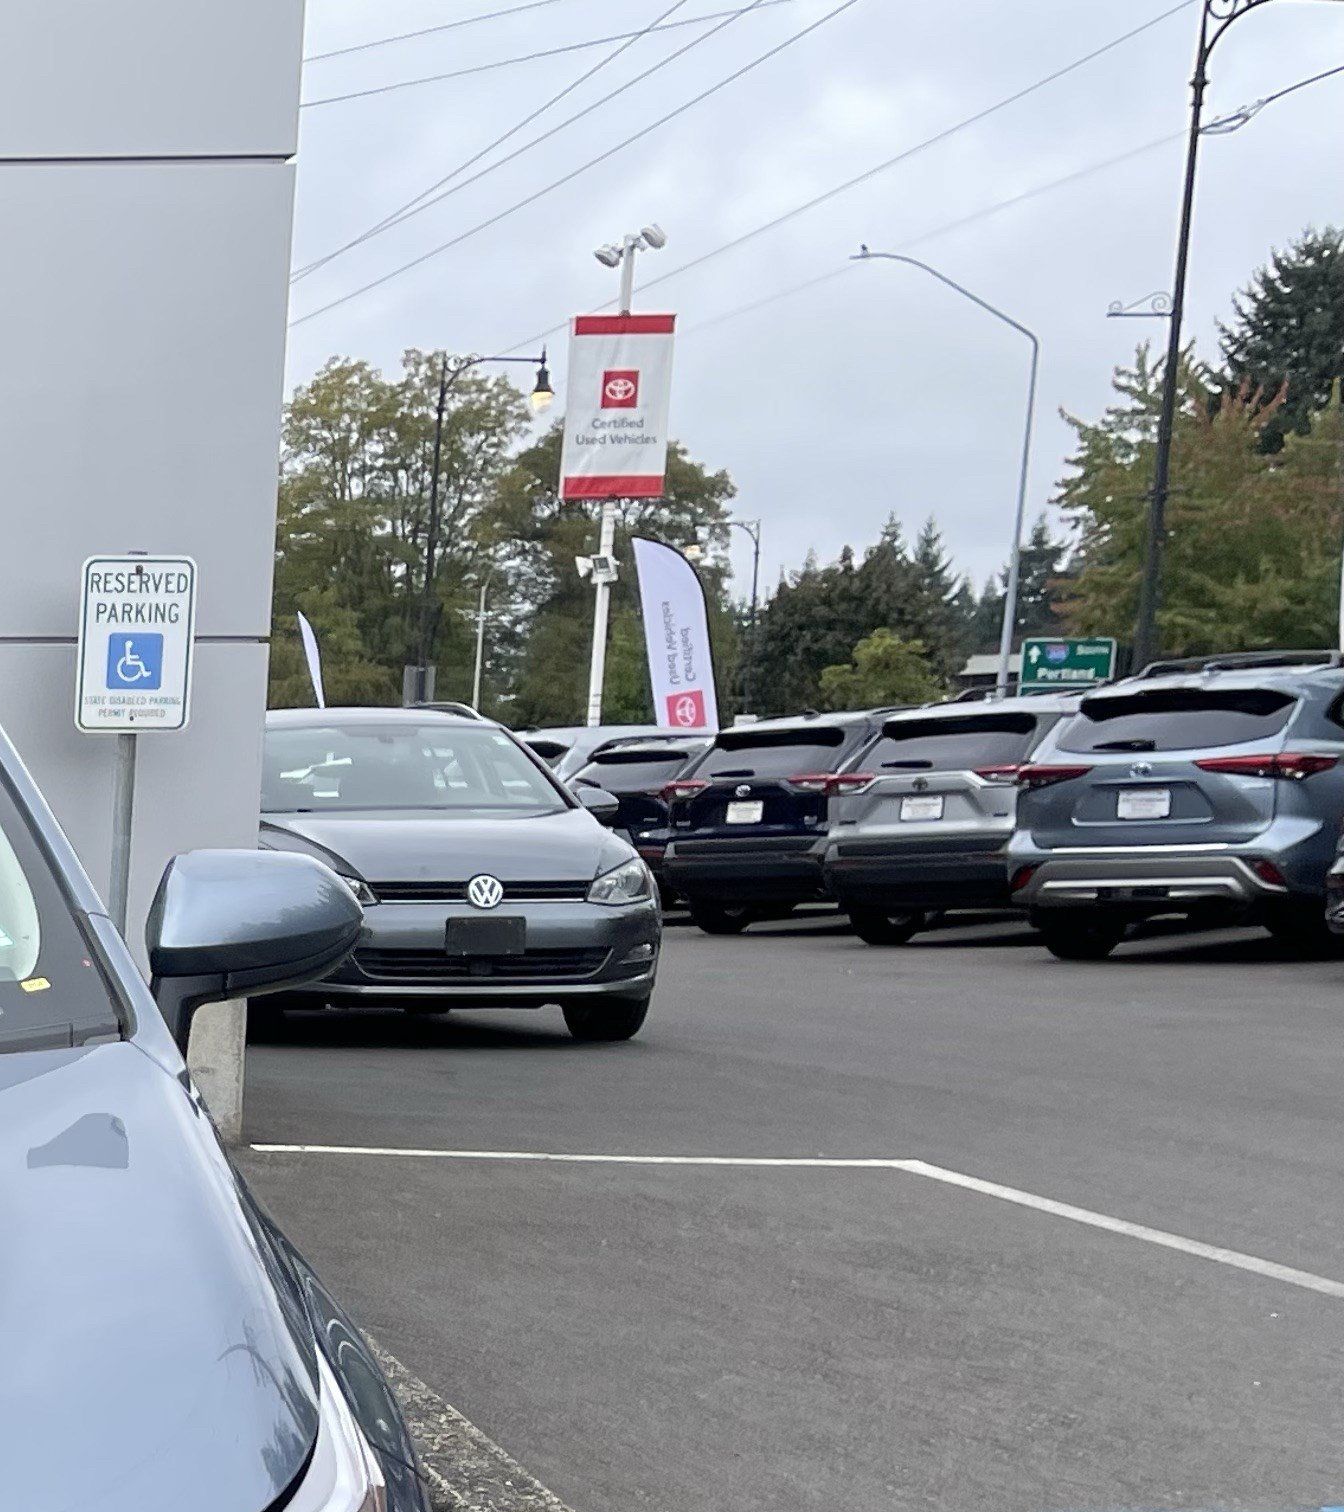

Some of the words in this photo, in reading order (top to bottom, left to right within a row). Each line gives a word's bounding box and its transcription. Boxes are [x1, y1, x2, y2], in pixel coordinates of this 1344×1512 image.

[591, 417, 645, 429] Certified
[576, 434, 606, 445] Used
[610, 434, 657, 445] Vehicles
[90, 572, 189, 594] RESERVED
[95, 602, 180, 624] PARKING
[1037, 667, 1095, 680] Portland
